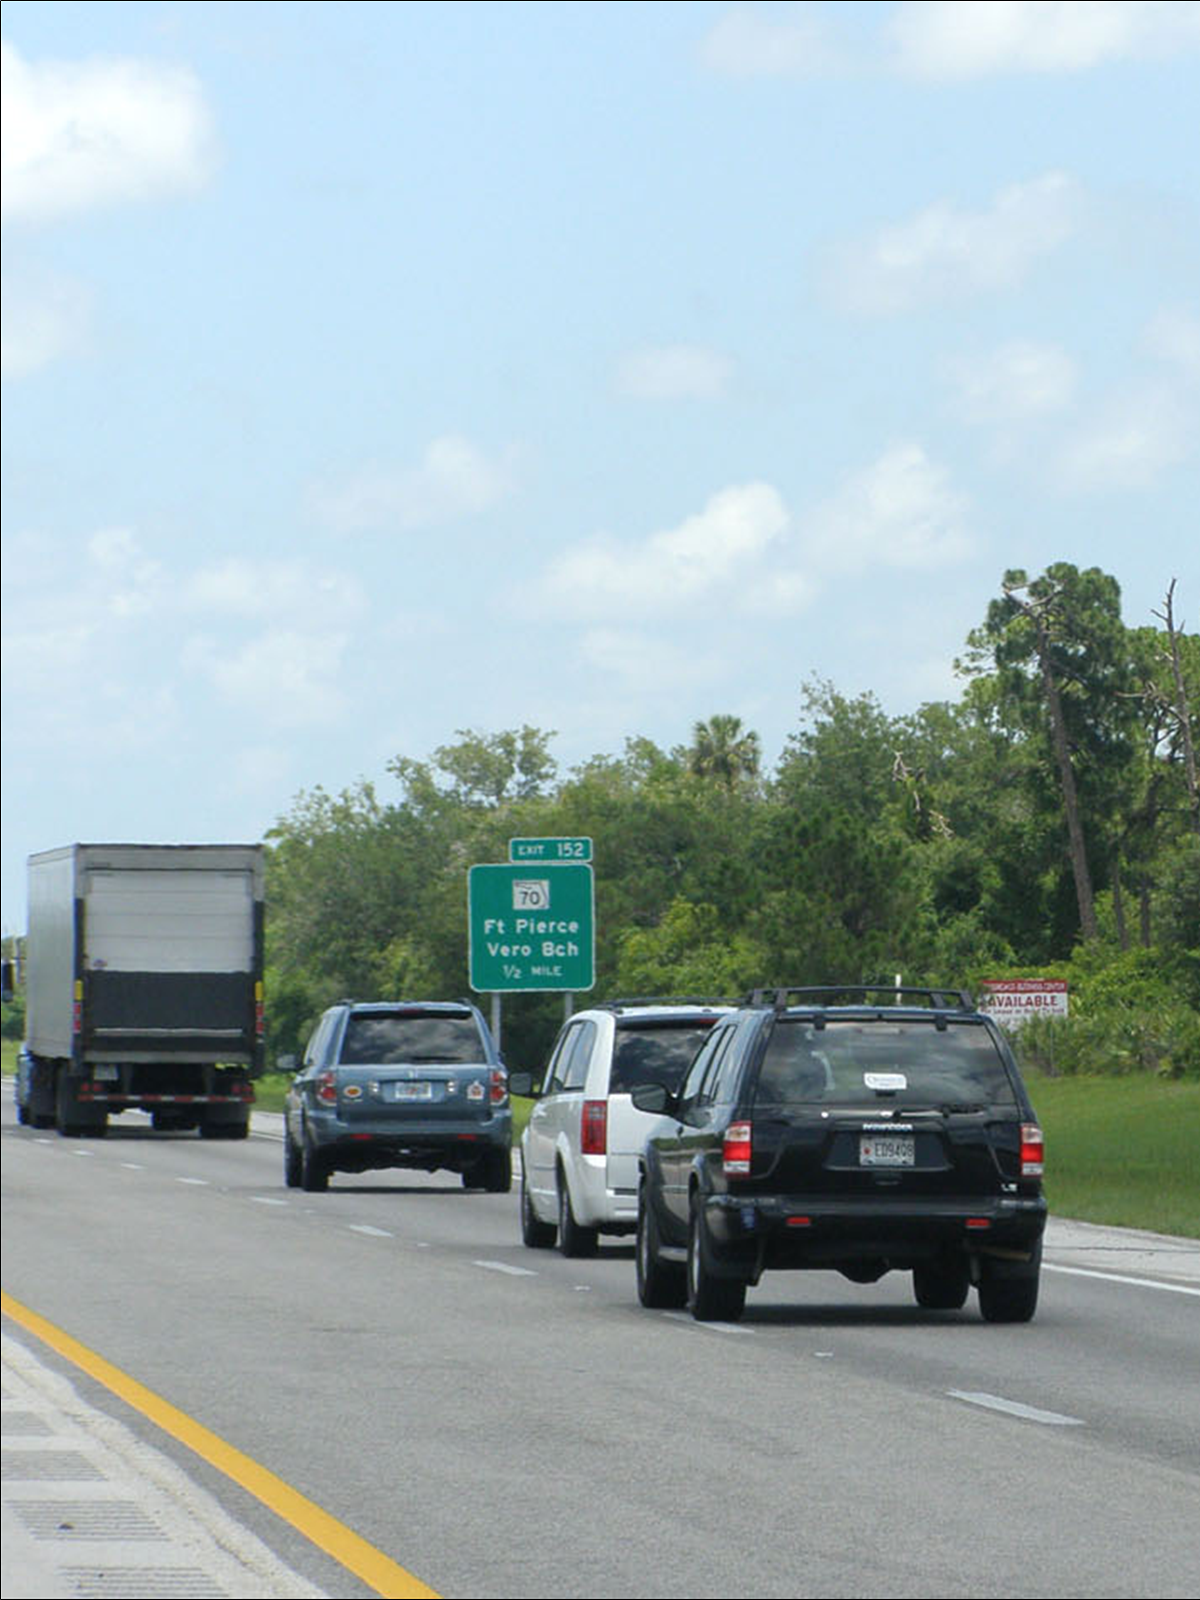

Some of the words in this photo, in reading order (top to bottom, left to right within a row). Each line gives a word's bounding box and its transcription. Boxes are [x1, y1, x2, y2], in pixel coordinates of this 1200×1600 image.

[517, 845, 545, 856] EXIT
[556, 843, 584, 857] 152
[520, 891, 541, 905] 70
[484, 919, 505, 934] Ft
[515, 918, 579, 934] Pierce
[486, 942, 532, 957] Vero
[541, 941, 579, 957] Bch
[530, 965, 563, 976] MILE
[988, 996, 1058, 1007] AVAILABLE
